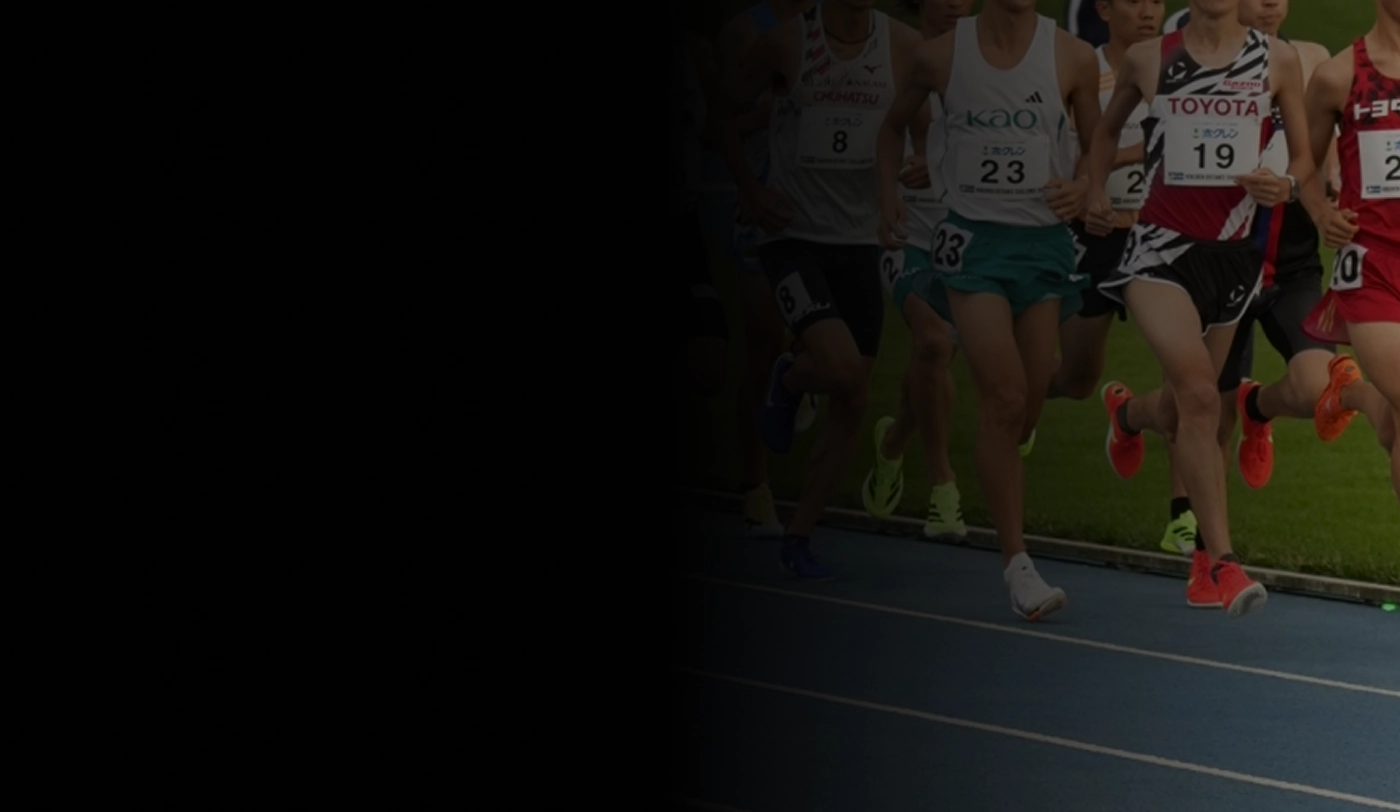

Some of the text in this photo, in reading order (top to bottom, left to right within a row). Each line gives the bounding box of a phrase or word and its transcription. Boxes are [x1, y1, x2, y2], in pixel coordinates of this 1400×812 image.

[1168, 97, 1259, 116] TOYOTA
[832, 130, 848, 153] 8
[1193, 143, 1235, 169] 19
[980, 160, 1025, 184] 23
[934, 229, 965, 267] 23
[778, 286, 796, 314] 8
